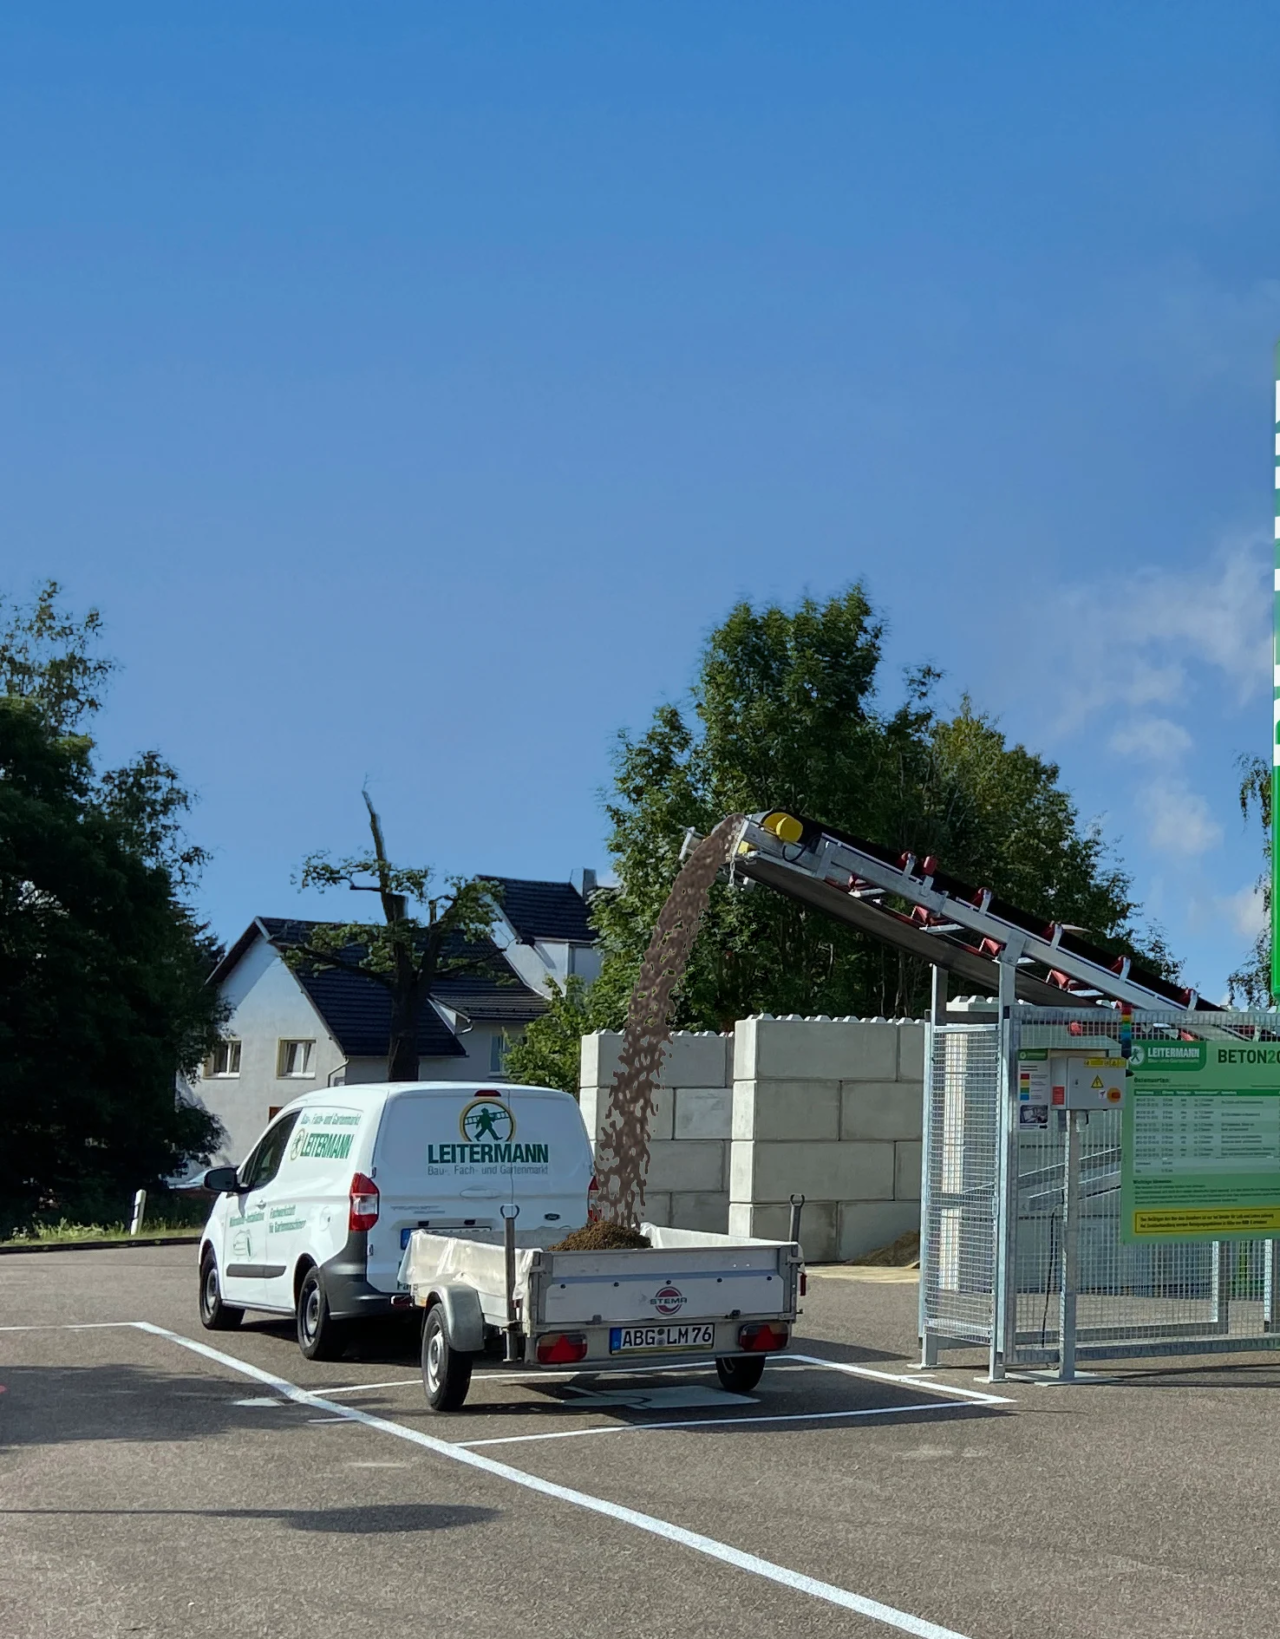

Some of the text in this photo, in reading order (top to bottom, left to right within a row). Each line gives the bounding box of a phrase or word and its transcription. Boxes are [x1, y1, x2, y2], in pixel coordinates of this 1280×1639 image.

[1147, 1046, 1200, 1058] LEITERMANN
[299, 1132, 355, 1160] LEITERMANN
[427, 1143, 549, 1164] LEITERMANN
[453, 1165, 479, 1175] Fach-
[481, 1165, 498, 1175] und
[500, 1164, 549, 1175] Gartenmarkt
[649, 1297, 688, 1305] STEMA
[622, 1326, 712, 1347] ABG LM 76
